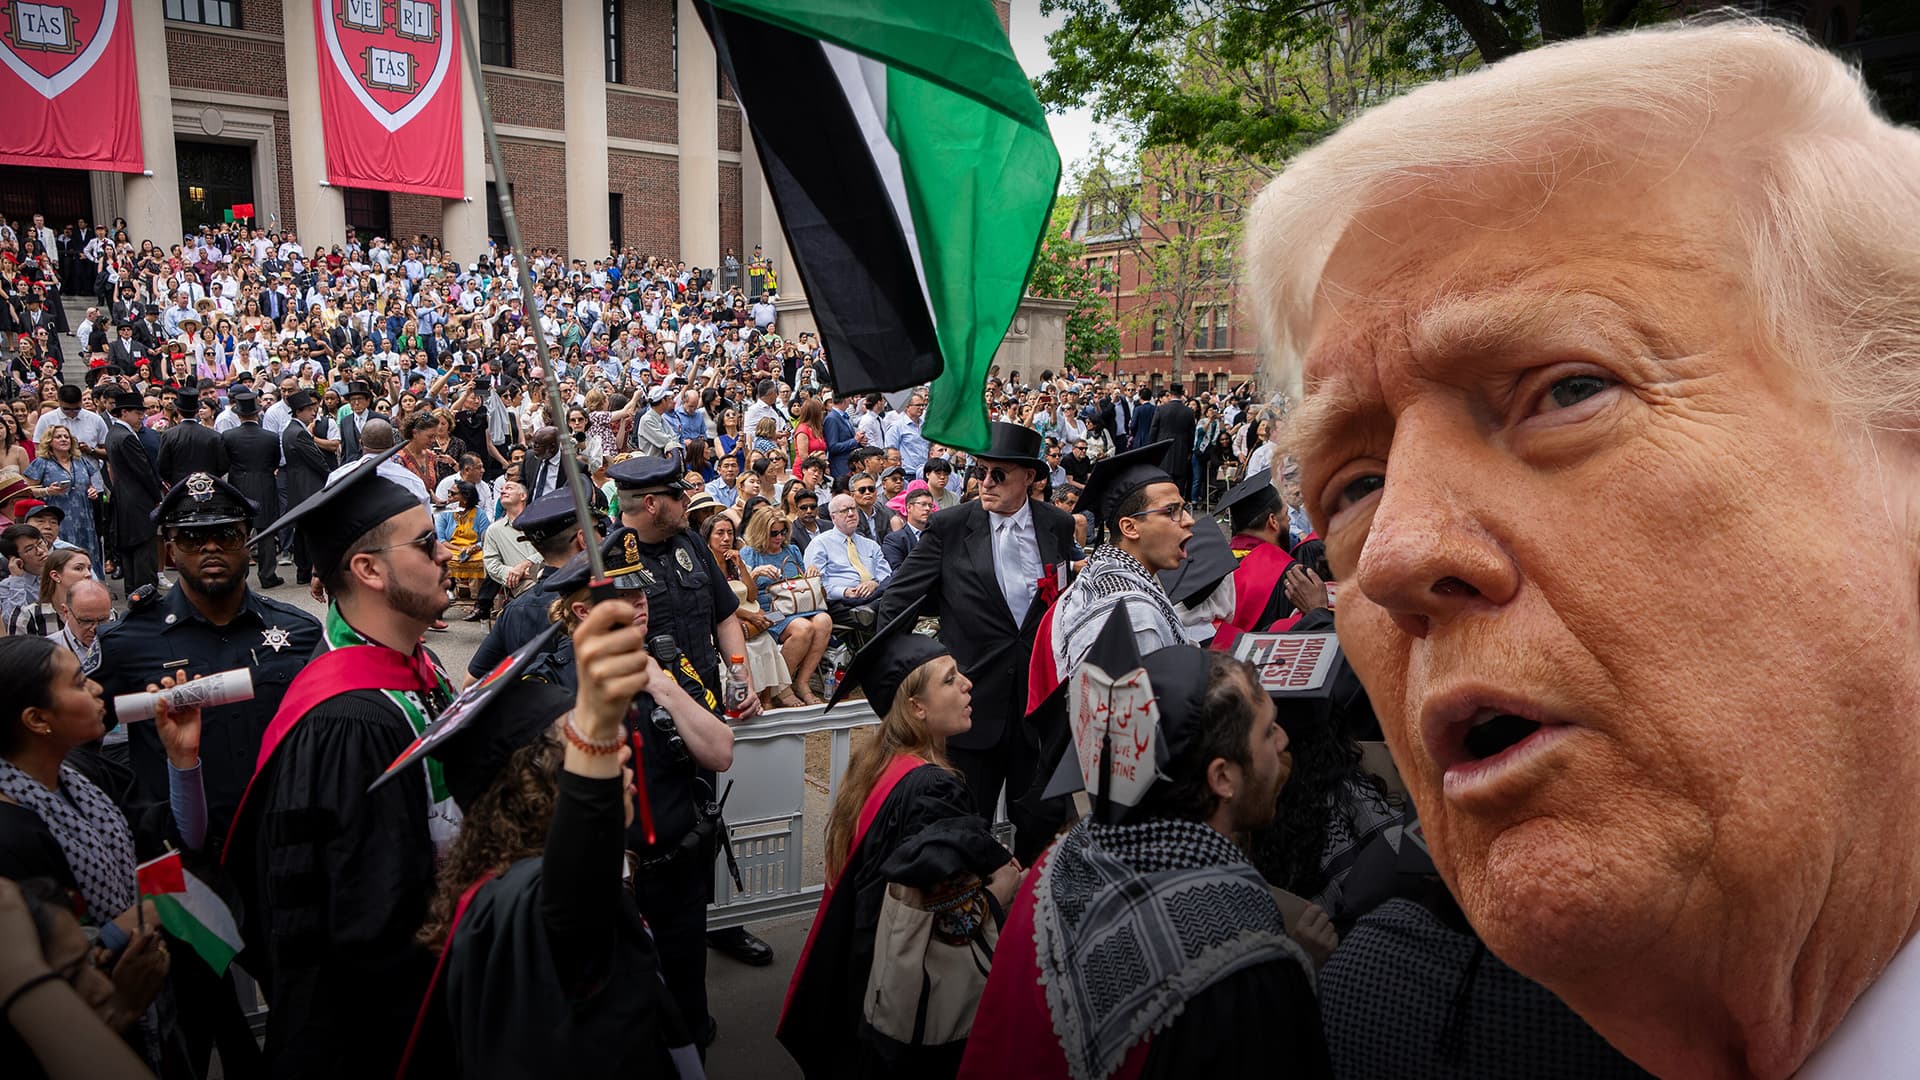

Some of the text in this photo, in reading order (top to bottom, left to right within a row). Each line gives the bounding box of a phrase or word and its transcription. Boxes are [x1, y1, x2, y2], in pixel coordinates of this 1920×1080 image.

[23, 12, 62, 35] TAS
[351, 0, 422, 27] VE RI
[376, 57, 406, 77] TAS
[1261, 639, 1305, 688] DIVEST
[1288, 637, 1327, 687] HARVARD
[734, 688, 746, 702] G
[1092, 753, 1136, 781] PSTINE
